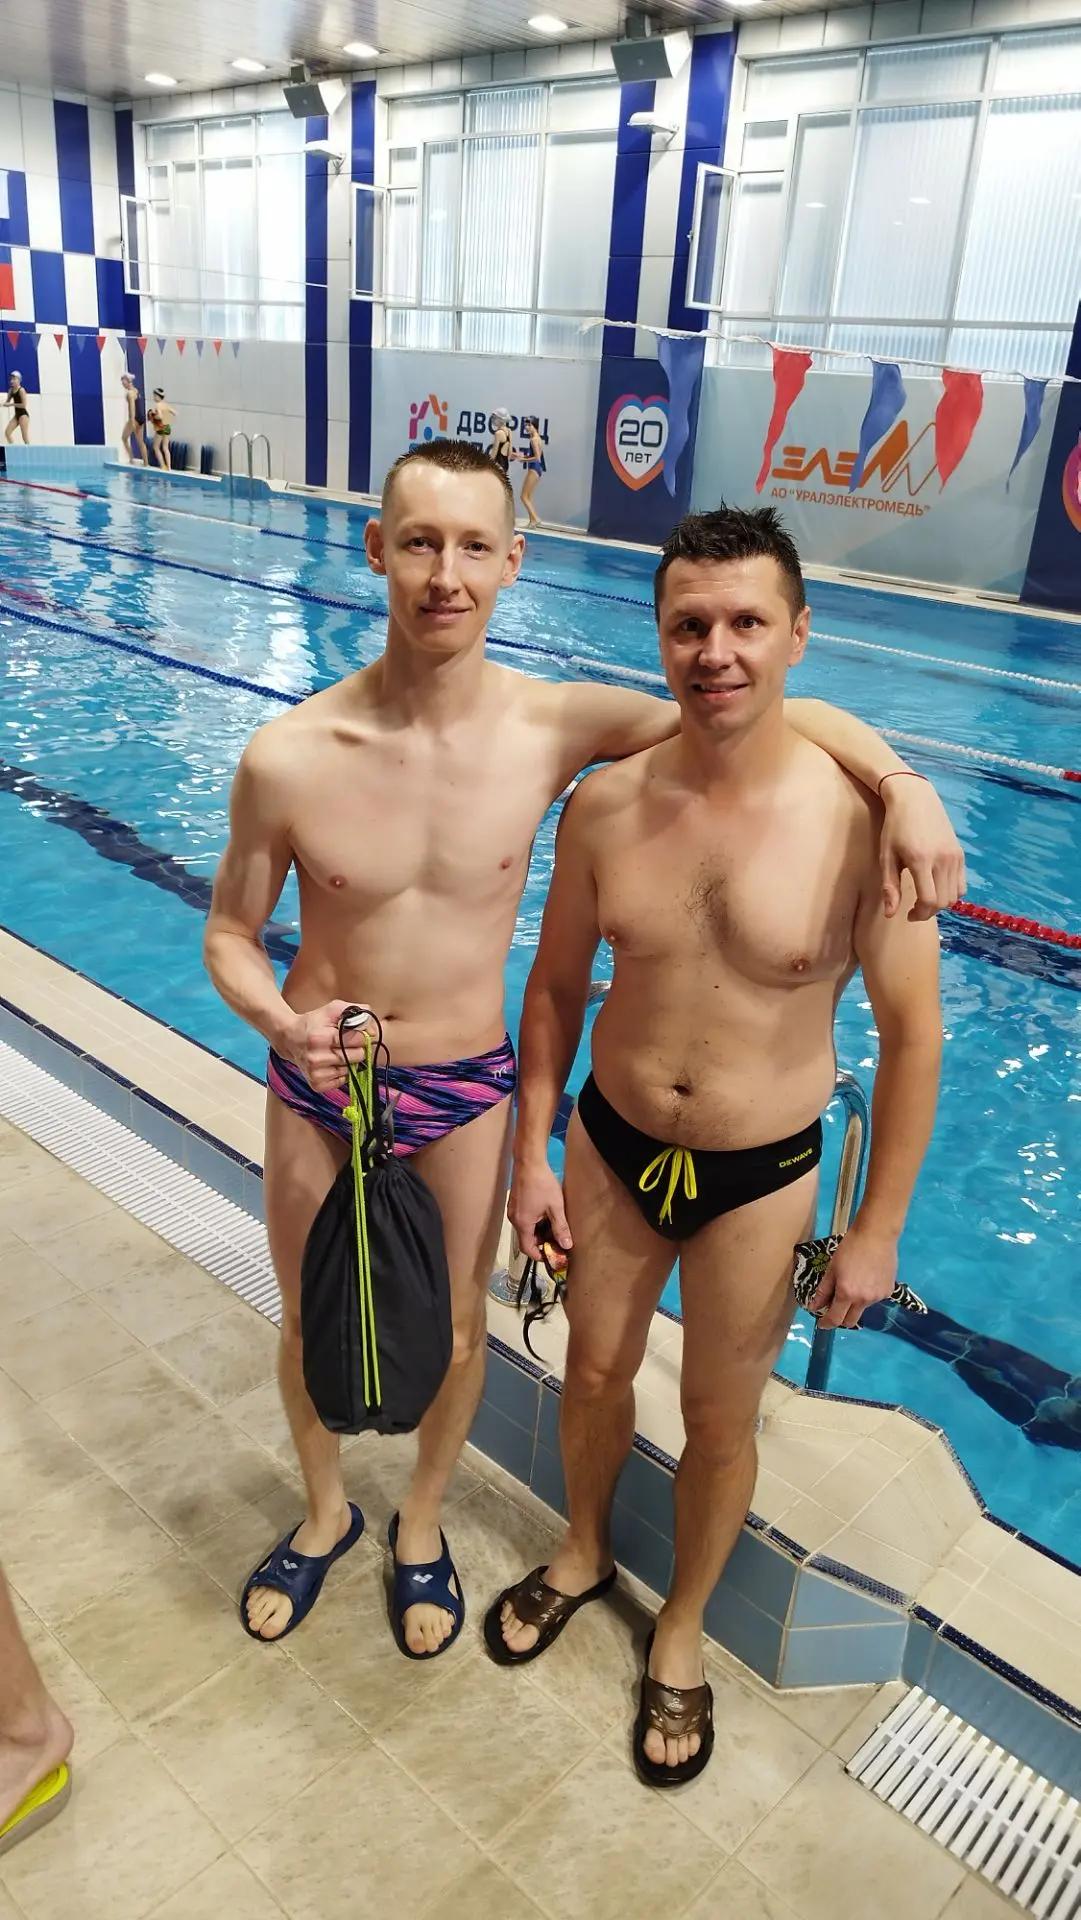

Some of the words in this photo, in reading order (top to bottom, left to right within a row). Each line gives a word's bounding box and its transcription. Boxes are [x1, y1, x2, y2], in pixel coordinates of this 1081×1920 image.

[619, 419, 663, 447] 20
[624, 452, 652, 463] лет
[771, 487, 787, 499] АО
